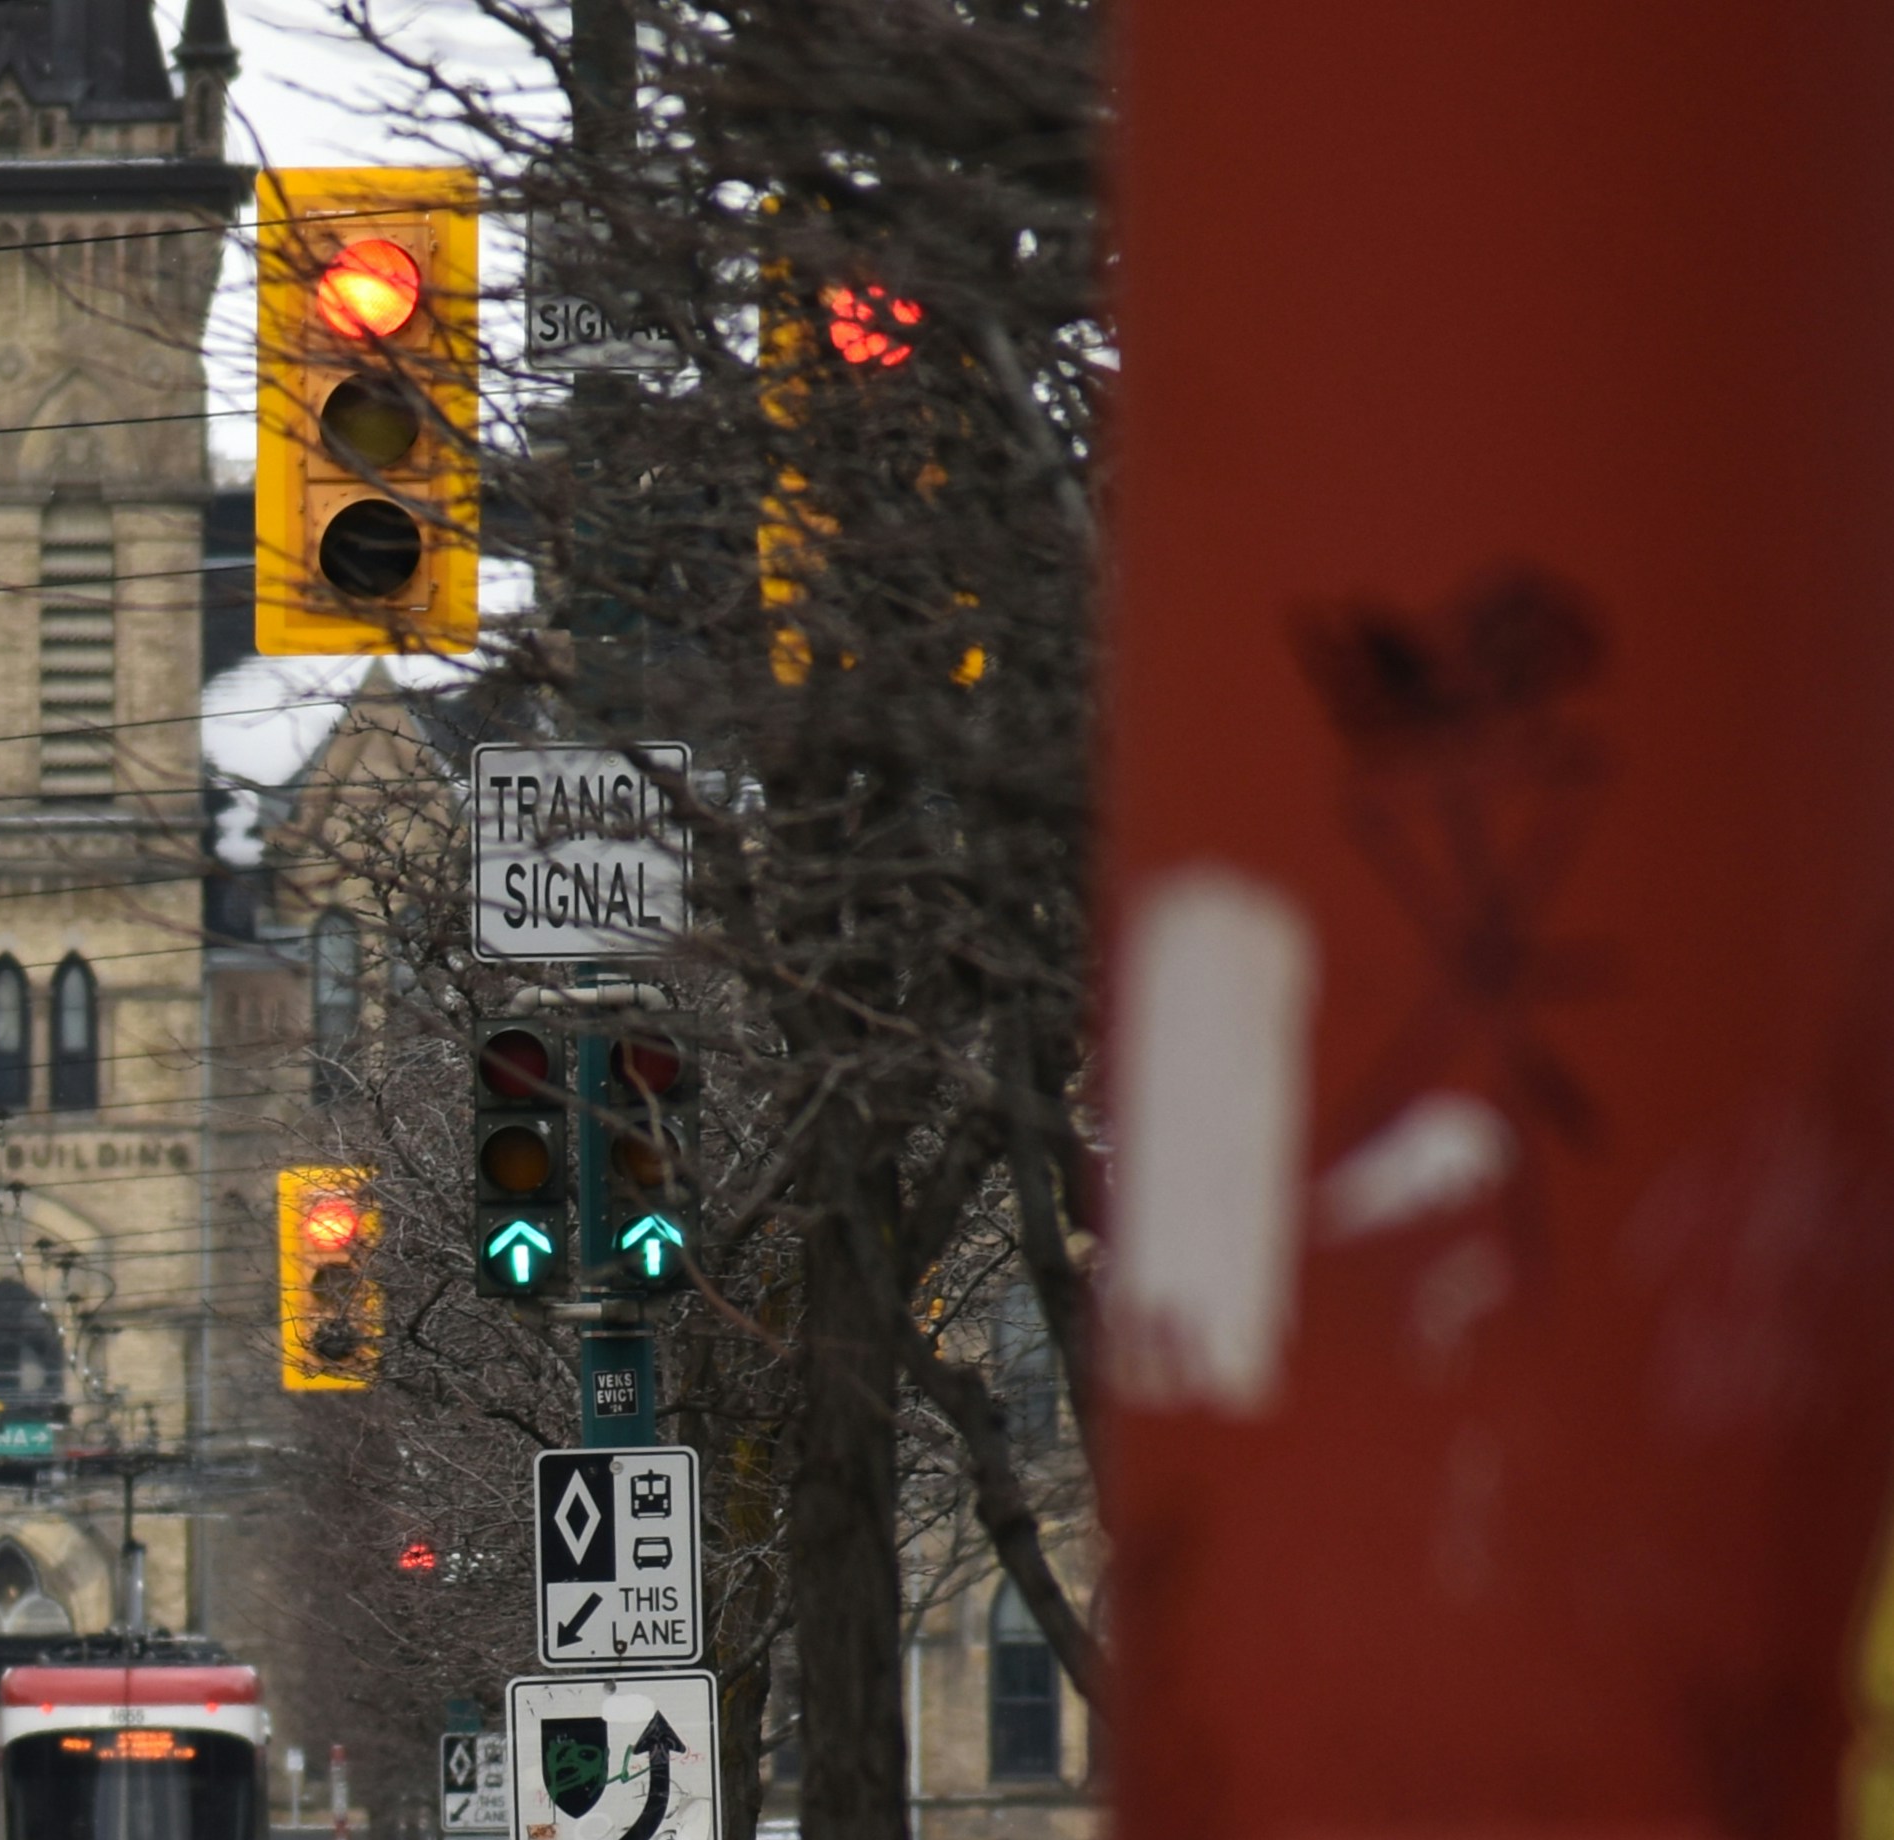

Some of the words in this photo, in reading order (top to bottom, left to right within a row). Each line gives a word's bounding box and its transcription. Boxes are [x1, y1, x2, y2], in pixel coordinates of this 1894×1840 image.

[491, 775, 668, 842] TRANSIT
[504, 862, 661, 929] SIGNAL
[6, 1141, 192, 1169] BUILDING
[596, 1387, 634, 1405] EVICT
[619, 1585, 679, 1613] THIS
[612, 1619, 687, 1647] LANE
